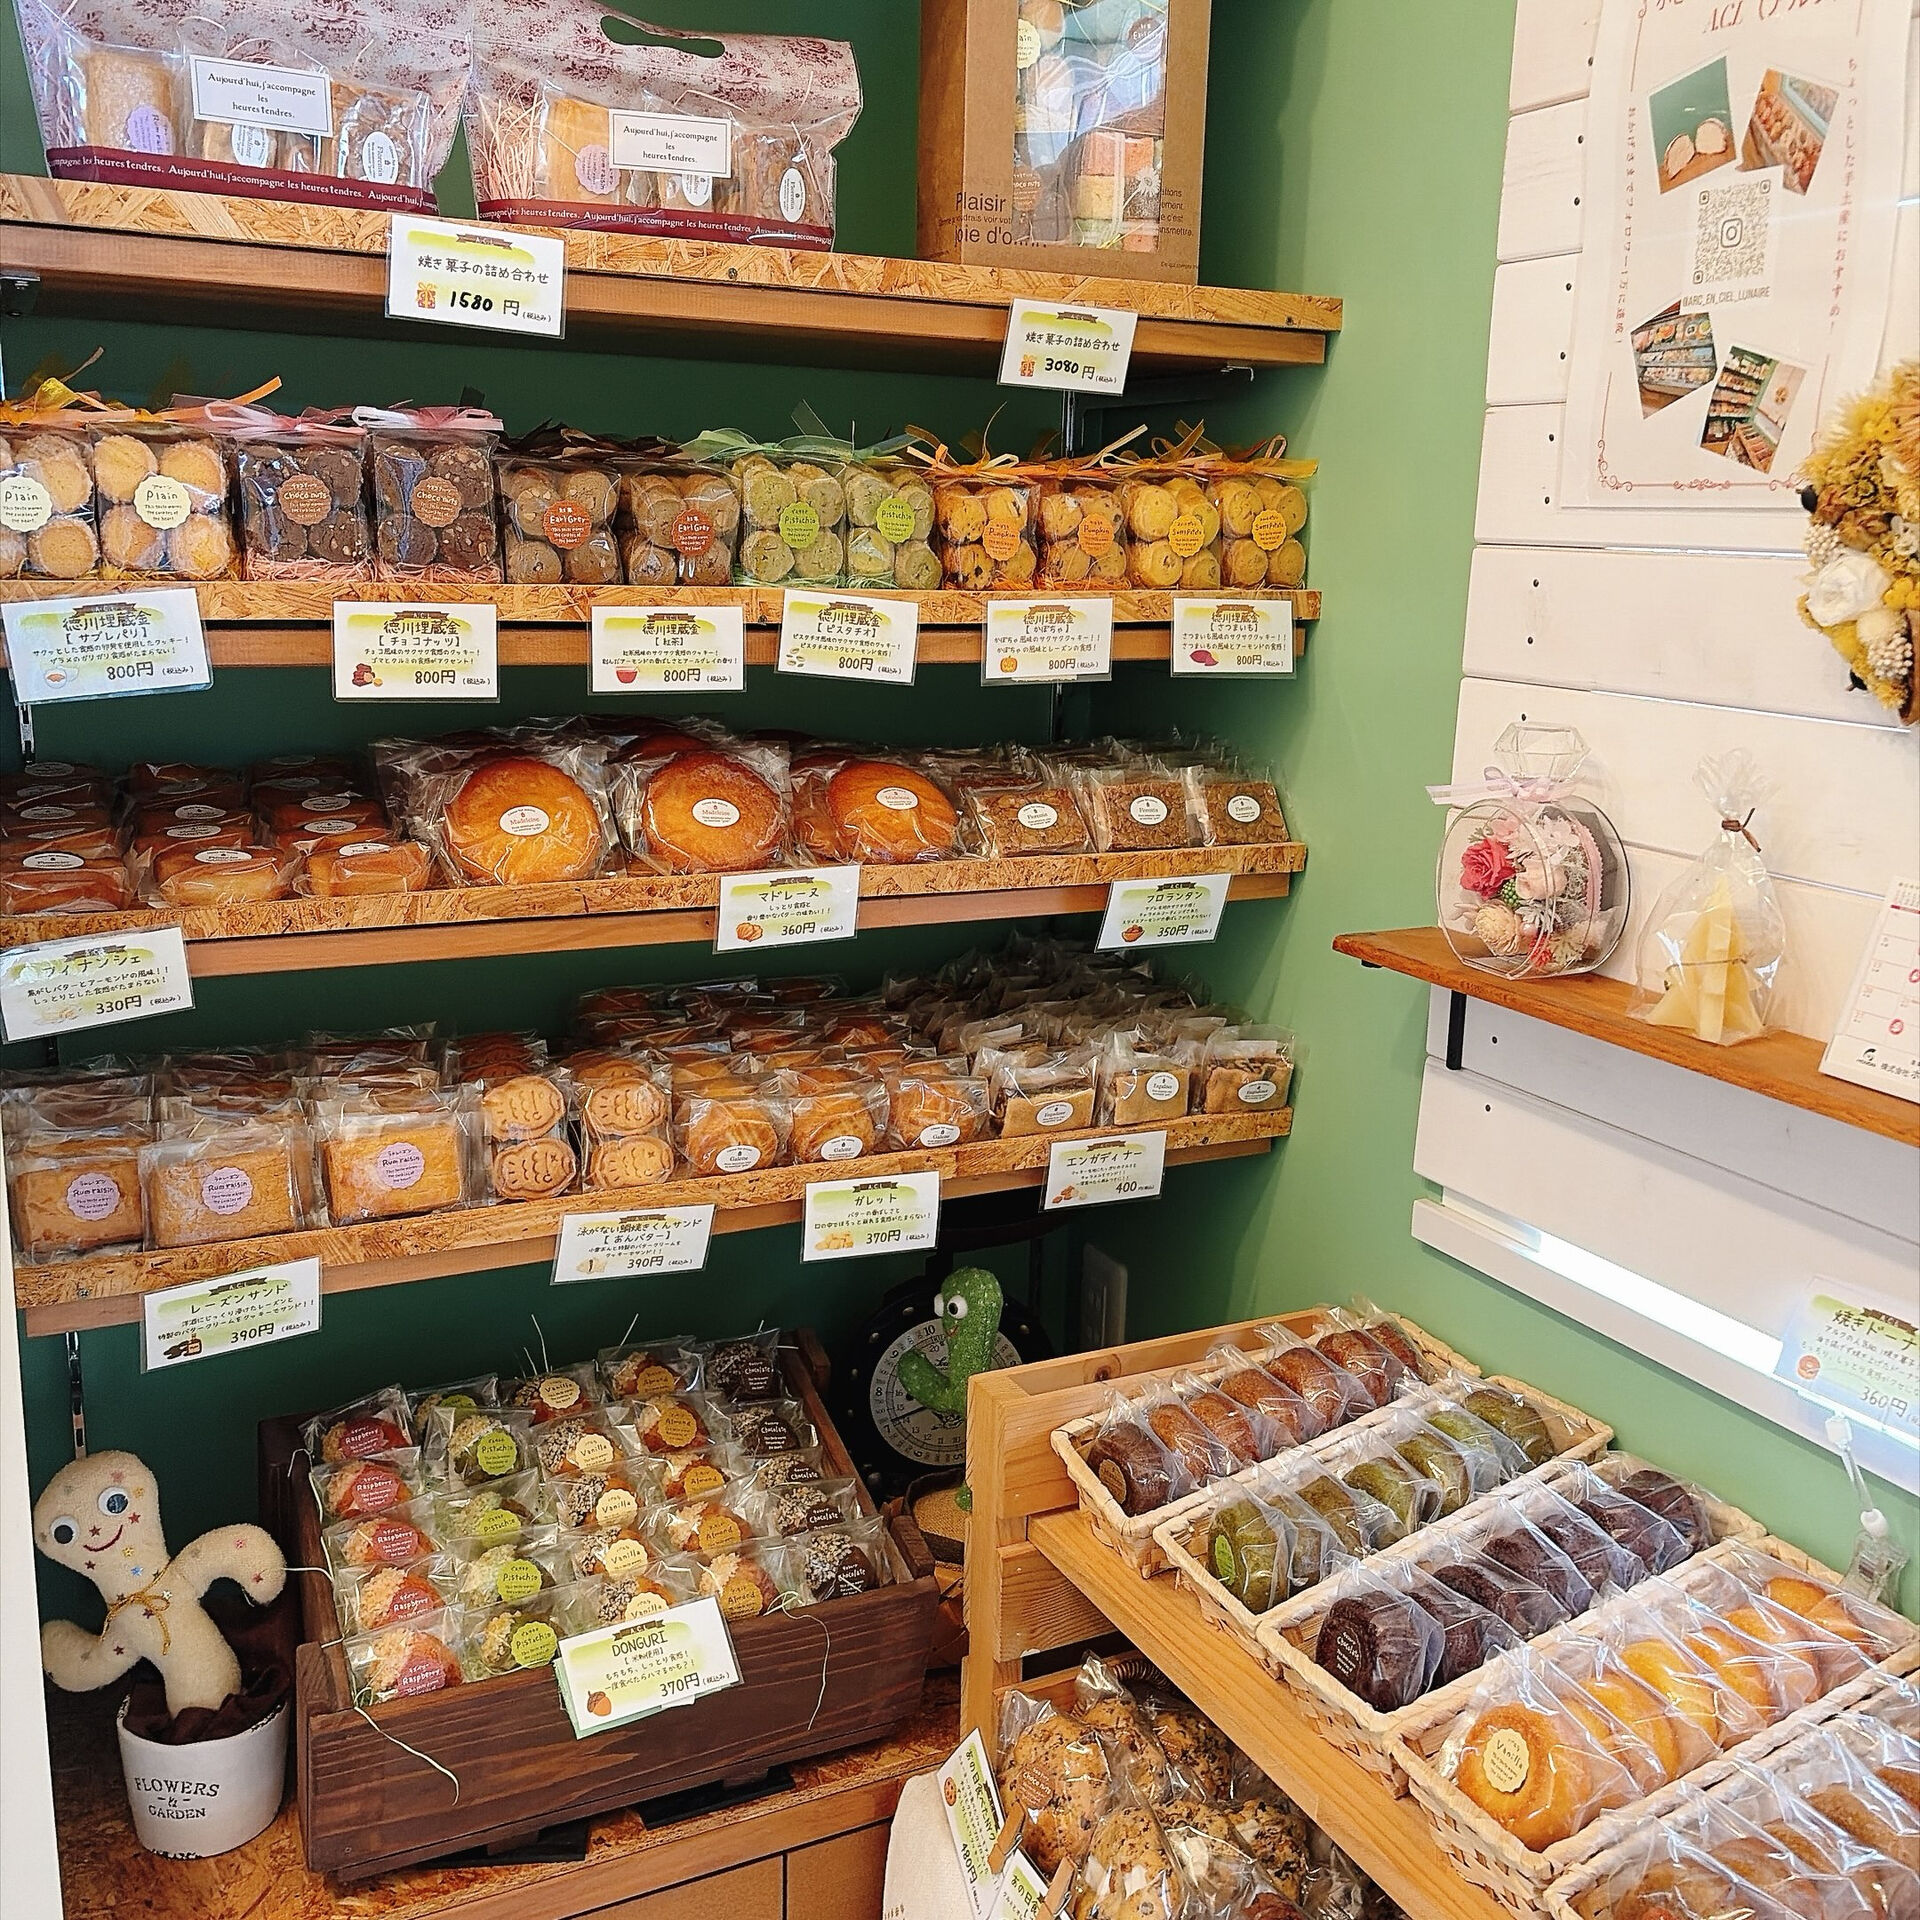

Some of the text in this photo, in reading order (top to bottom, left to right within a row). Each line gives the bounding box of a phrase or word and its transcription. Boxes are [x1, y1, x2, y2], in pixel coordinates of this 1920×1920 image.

[257, 94, 268, 103] les
[232, 102, 295, 118] heures tendres.
[643, 152, 697, 164] heures tendres.
[82, 157, 92, 165] les
[94, 156, 125, 169] heures
[126, 159, 164, 174] tendres.
[287, 180, 299, 190] les
[301, 181, 329, 194] heures
[330, 185, 364, 198] tendres.
[956, 192, 1006, 212] Plaisir
[521, 208, 547, 218] heures
[548, 209, 580, 219] tendres.
[687, 219, 696, 228] les
[698, 221, 723, 231] heures
[724, 222, 752, 233] tendres.
[418, 254, 549, 285] 焼き菓子の詰め合わせ
[450, 291, 493, 311] 1580
[503, 300, 520, 317] 円
[1025, 331, 1121, 352] 焼き菓子の詰め合わせ
[1045, 358, 1095, 380] 3080 円
[5, 491, 38, 502] Plain
[147, 490, 178, 501] Plain
[284, 491, 308, 499] Choco
[417, 491, 440, 501] Choco
[550, 515, 586, 524] Earl Grey
[784, 516, 816, 524] Pistachio
[881, 511, 911, 520] Pistachio
[678, 524, 694, 532] Earl
[989, 528, 1015, 538] Pumpkin
[1084, 526, 1109, 534] Pumpkin
[62, 611, 152, 632] 徳川埋蔵金
[818, 609, 882, 628] 徳川埋蔵金
[1023, 613, 1076, 625] 徳川埋蔵金
[1212, 612, 1260, 624] 徳川埋蔵金
[383, 620, 461, 636] 徳川埋蔵金
[642, 624, 701, 636] 徳川埋蔵金
[838, 656, 874, 671] 800円
[1049, 658, 1076, 670] 800円
[1236, 654, 1262, 666] 800円
[106, 661, 154, 680] 800円
[663, 668, 701, 682] 800円
[415, 670, 456, 685] 800円
[759, 887, 819, 902] マドレーヌ
[1147, 891, 1203, 903] フロランタン
[781, 922, 816, 936] 360円
[1157, 924, 1189, 938] 350円
[96, 995, 142, 1015] 330円
[382, 1159, 398, 1167] Rum
[1066, 1150, 1142, 1167] エンガディナー
[73, 1187, 115, 1197] Rum raisin
[208, 1181, 248, 1192] Rum raisin
[1116, 1181, 1137, 1194] 400
[854, 1193, 897, 1206] ガレット
[577, 1218, 702, 1237] 泳がない鯛焼きくんサンド
[866, 1229, 901, 1245] 370円
[627, 1255, 664, 1269] 390円
[190, 1283, 288, 1314] レーズンサンド
[230, 1322, 275, 1344] 390円
[923, 1324, 936, 1336] 10
[890, 1350, 899, 1358] 9
[929, 1344, 940, 1353] 20
[545, 1383, 573, 1393] Vanilla
[875, 1387, 883, 1396] 8
[1859, 1386, 1908, 1418] 360円
[665, 1418, 691, 1426] Almond
[761, 1426, 787, 1434] Chocolate
[883, 1425, 890, 1433] 7
[345, 1429, 379, 1444] Raspberry
[482, 1445, 514, 1453] Pistachio
[580, 1445, 607, 1457] Vanilla
[690, 1476, 718, 1485] Almond
[790, 1471, 819, 1480] Chocolate
[357, 1480, 392, 1491] Raspberry
[602, 1501, 631, 1513] Vanilla
[809, 1511, 839, 1523] Chocolate
[483, 1518, 515, 1532] Pistachio
[377, 1531, 413, 1544] Raspberry
[706, 1527, 733, 1540] Almond
[611, 1550, 641, 1563] Vanilla
[503, 1573, 538, 1582] Pistachio
[393, 1597, 428, 1613] Raspberry
[727, 1593, 755, 1604] Almond
[631, 1604, 662, 1618] Vanilla
[516, 1632, 551, 1649] Pistachio
[612, 1631, 668, 1657] DONGURI
[402, 1669, 441, 1686] Raspberry
[659, 1673, 700, 1697] 370円
[1497, 1739, 1523, 1769] Vanilla
[135, 1778, 219, 1797] FLOWERS
[148, 1805, 206, 1819] GARDEN
[961, 1843, 978, 1884] 480円
